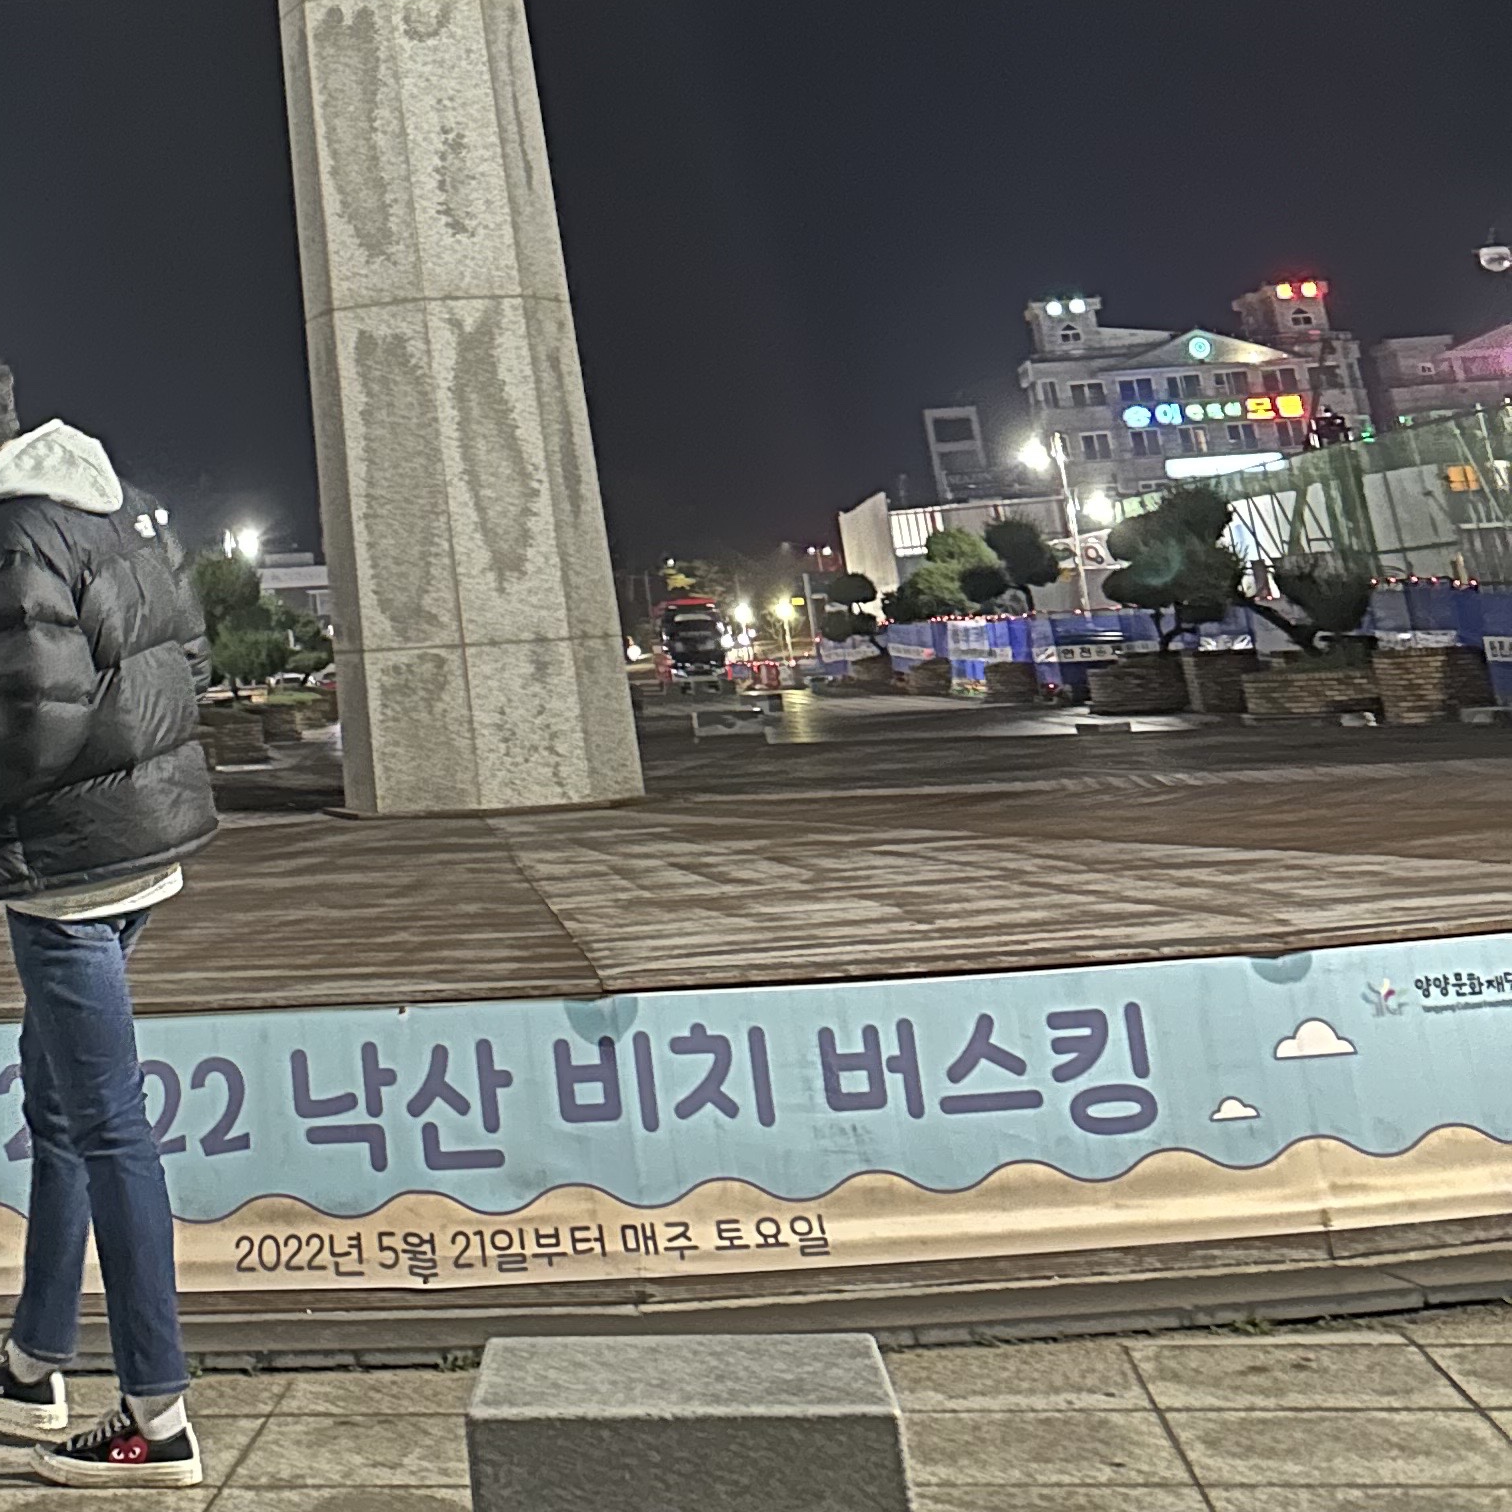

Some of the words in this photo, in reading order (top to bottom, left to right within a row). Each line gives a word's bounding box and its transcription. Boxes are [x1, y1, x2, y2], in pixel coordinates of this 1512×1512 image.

[289, 1038, 513, 1173] 낙산
[553, 1023, 776, 1134] 비치
[816, 1001, 1159, 1136] 버스킹
[234, 1233, 366, 1277] 2022년
[377, 1231, 439, 1279] 5월
[452, 1223, 608, 1274] 21일부터
[621, 1221, 699, 1260] 매주
[713, 1213, 832, 1258] 토요일
